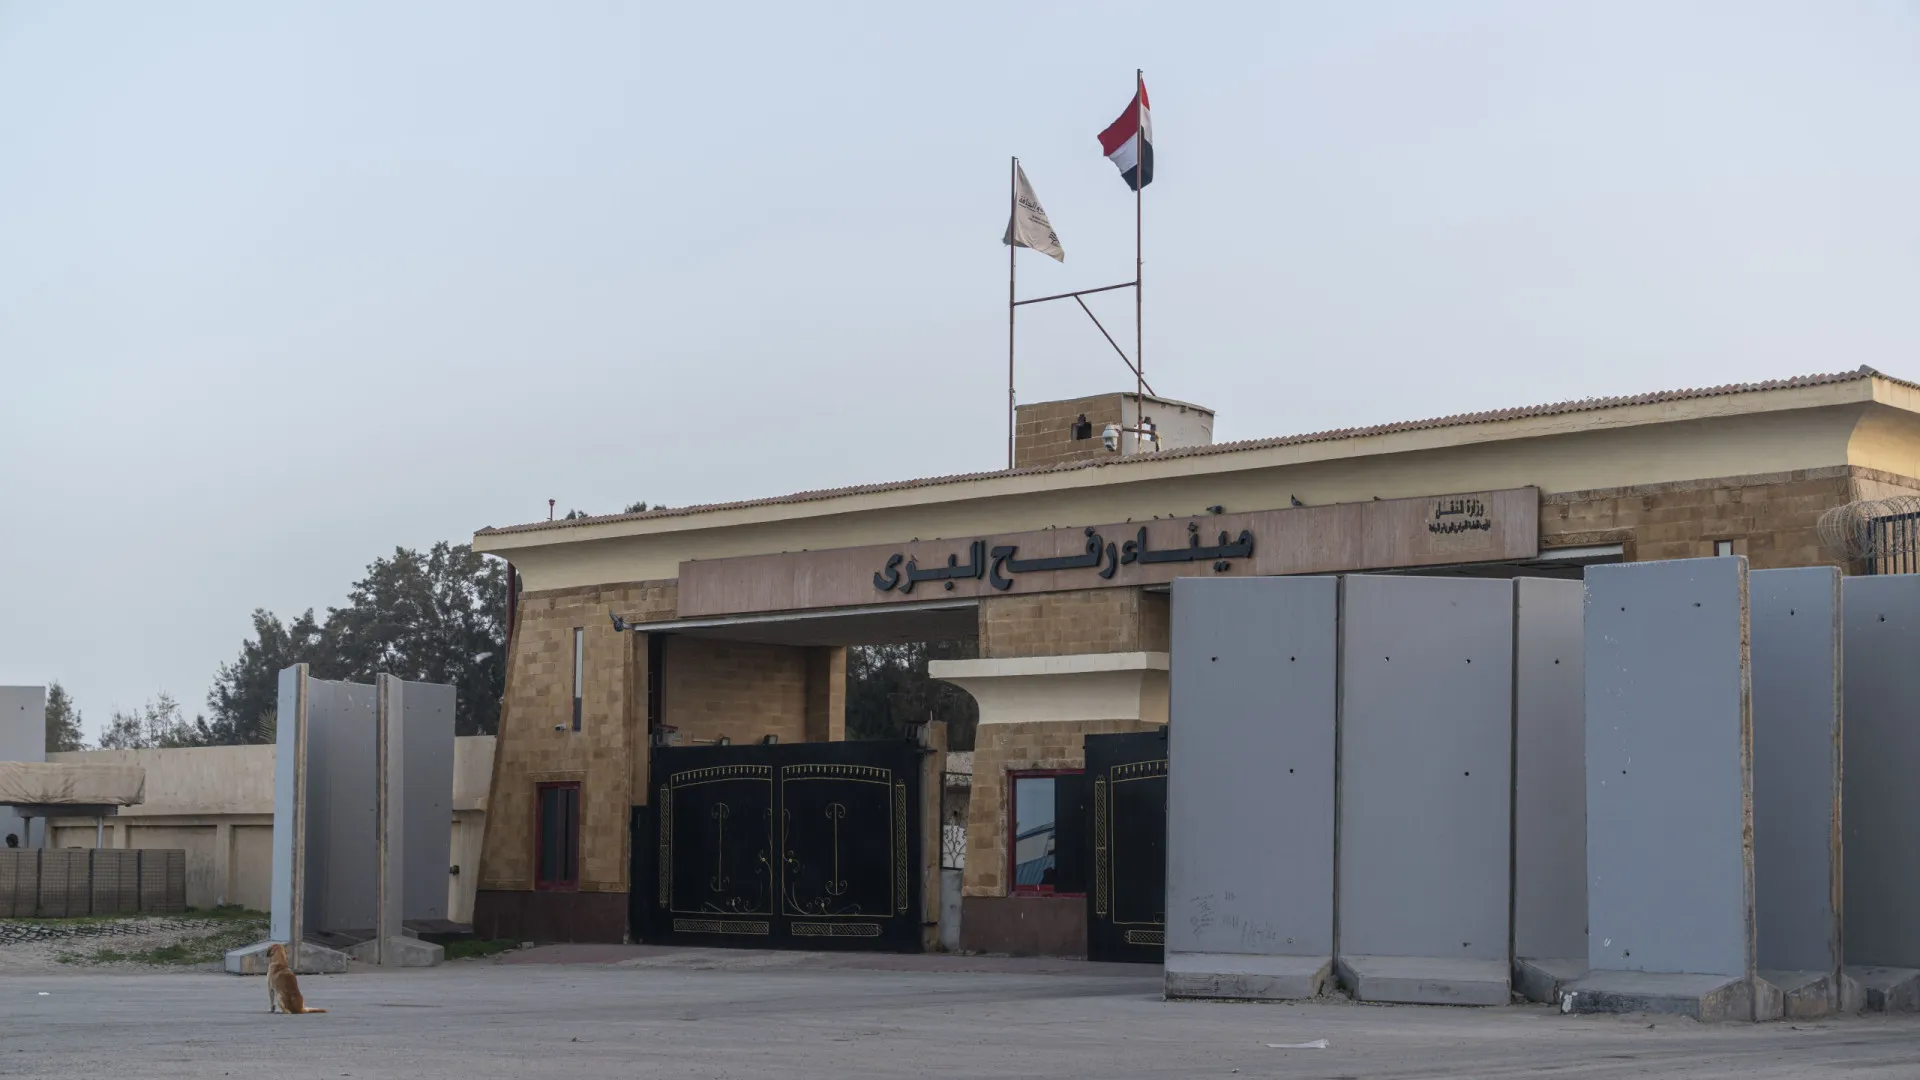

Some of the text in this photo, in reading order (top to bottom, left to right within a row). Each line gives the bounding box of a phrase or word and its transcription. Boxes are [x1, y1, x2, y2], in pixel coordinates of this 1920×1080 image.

[1435, 498, 1484, 520] وزارة النقل
[989, 525, 1118, 590] رفح
[1120, 521, 1254, 572] ميناء
